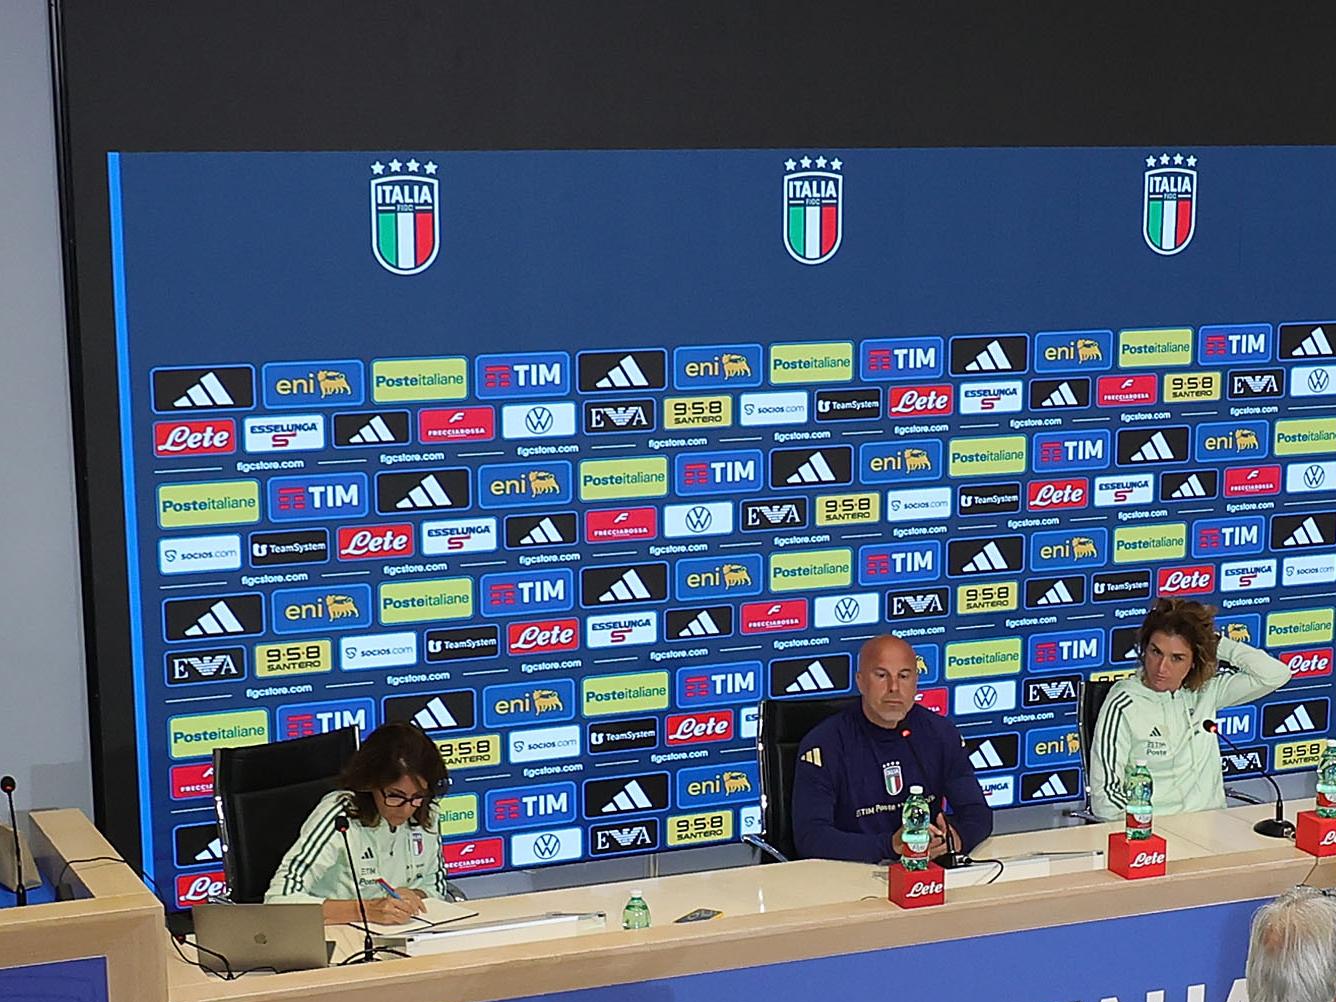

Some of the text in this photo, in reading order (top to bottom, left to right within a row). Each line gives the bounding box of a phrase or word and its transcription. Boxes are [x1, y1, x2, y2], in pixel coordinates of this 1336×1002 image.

[788, 180, 837, 198] ITALIA
[1149, 176, 1192, 193] ITALIA
[377, 185, 432, 204] ITALIA
[1228, 333, 1265, 354] TIM
[1045, 341, 1075, 361] eni
[894, 348, 935, 369] TIM
[685, 357, 720, 377] eni
[514, 363, 560, 386] TIM
[275, 372, 314, 395] eni
[964, 388, 1018, 398] ESSELUNGA
[1172, 389, 1213, 398] SANTERO
[832, 399, 880, 410] TeamSystem
[891, 391, 948, 412] Lete
[757, 404, 805, 414] socios.com
[1230, 405, 1279, 417] figcstore.com
[674, 415, 722, 425] SANTERO
[1010, 417, 1062, 429] figcstore.com
[1120, 411, 1171, 423] figcstore.com
[250, 423, 318, 434] ESSELUNGA
[894, 424, 949, 436] figcstore.com
[158, 426, 229, 451] Lete
[773, 430, 831, 443] figcstore.com
[1205, 431, 1233, 451] eni
[648, 437, 707, 450] figcstore.com
[1064, 439, 1103, 460] TIM
[516, 444, 579, 457] figcstore.com
[380, 451, 445, 465] figcstore.com
[870, 452, 902, 471] eni
[236, 459, 304, 472] figcstore.com
[711, 461, 755, 483] TIM
[490, 473, 526, 496] eni
[1099, 480, 1149, 490] ESSELUNGA
[308, 484, 359, 508] TIM
[974, 493, 1018, 505] TeamSystem
[1029, 485, 1082, 506] Lete
[904, 500, 948, 510] socios.com
[1226, 501, 1275, 513] figcstore.com
[825, 512, 870, 521] SANTERO
[1118, 509, 1168, 520] figcstore.com
[1008, 517, 1059, 528] figcstore.com
[427, 525, 491, 537] ESSELUNGA
[893, 525, 947, 537] figcstore.com
[1222, 527, 1258, 547] TIM
[340, 531, 407, 555] Lete
[774, 534, 830, 546] figcstore.com
[269, 540, 326, 554] TeamSystem
[650, 543, 708, 556] figcstore.com
[1040, 538, 1070, 559] eni
[180, 549, 238, 560] socios.com
[519, 552, 580, 565] figcstore.com
[383, 562, 447, 575] figcstore.com
[892, 551, 932, 573] TIM
[687, 565, 720, 588] eni
[1225, 565, 1272, 577] ESSELUNGA
[1297, 566, 1335, 575] socios.com
[241, 572, 308, 585] figcstore.com
[1160, 571, 1210, 592] Lete
[519, 580, 564, 603] TIM
[1107, 580, 1148, 591] TeamSystem
[966, 599, 1008, 609] SANTERO
[1222, 596, 1270, 607] figcstore.com
[285, 601, 322, 620] eni
[591, 618, 651, 630] ESSELUNGA
[1006, 616, 1057, 627] figcstore.com
[444, 637, 497, 650] TeamSystem
[511, 626, 574, 650] Lete
[774, 637, 829, 649] figcstore.com
[360, 645, 413, 656] socios.com
[650, 648, 708, 660] figcstore.com
[1059, 639, 1097, 660] TIM
[266, 661, 321, 671] SANTERO
[521, 660, 582, 672] figcstore.com
[387, 672, 450, 684] figcstore.com
[711, 672, 754, 695] TIM
[246, 684, 312, 698] figcstore.com
[495, 693, 530, 715] eni
[1003, 712, 1054, 724] figcstore.com
[606, 729, 655, 741] TeamSystem
[669, 718, 728, 741] Lete
[528, 738, 577, 749] socios.com
[1035, 736, 1065, 755] eni
[651, 750, 708, 762] figcstore.com
[523, 763, 583, 776] figcstore.com
[688, 776, 720, 796] eni
[522, 792, 568, 816] TIM
[677, 830, 723, 840] SANTERO
[444, 858, 495, 868] RECCIAROSSA
[1130, 852, 1165, 868] Lete
[906, 882, 943, 898] Lete
